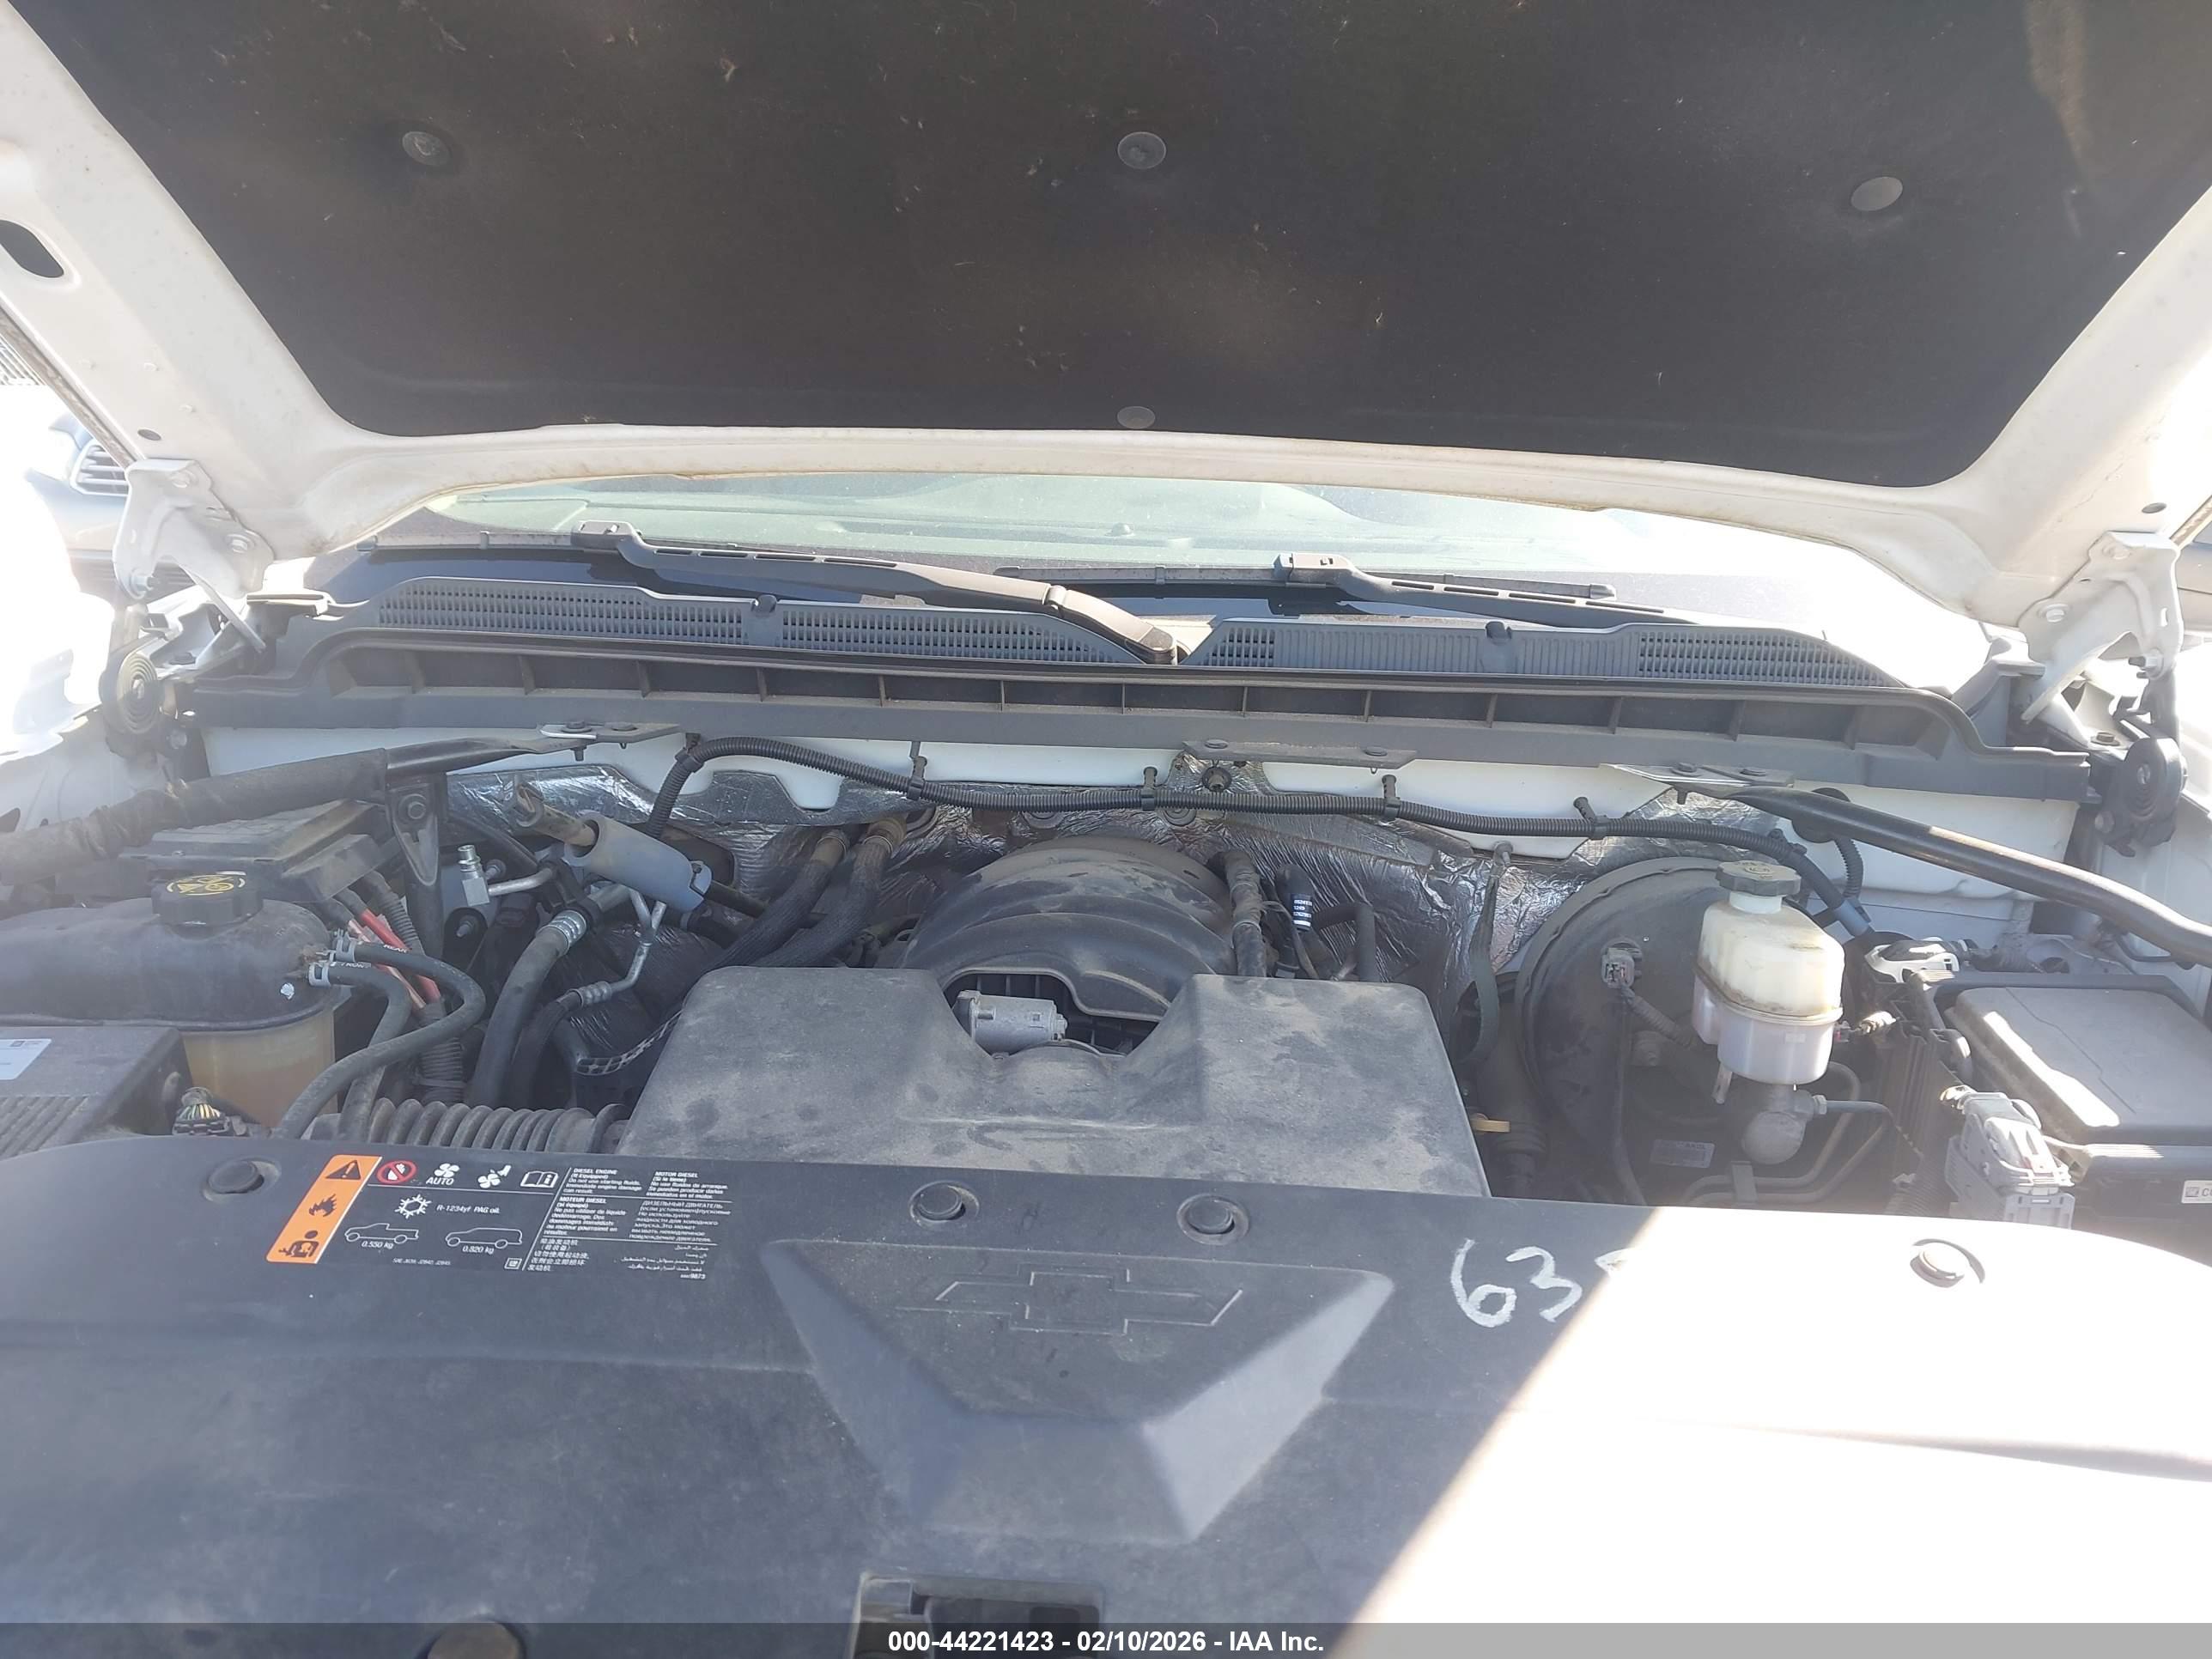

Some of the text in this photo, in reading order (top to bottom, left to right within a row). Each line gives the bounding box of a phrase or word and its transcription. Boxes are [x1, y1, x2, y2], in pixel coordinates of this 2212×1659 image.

[425, 1176, 454, 1185] AUTO
[384, 1242, 394, 1250] kg
[484, 1246, 495, 1255] kg
